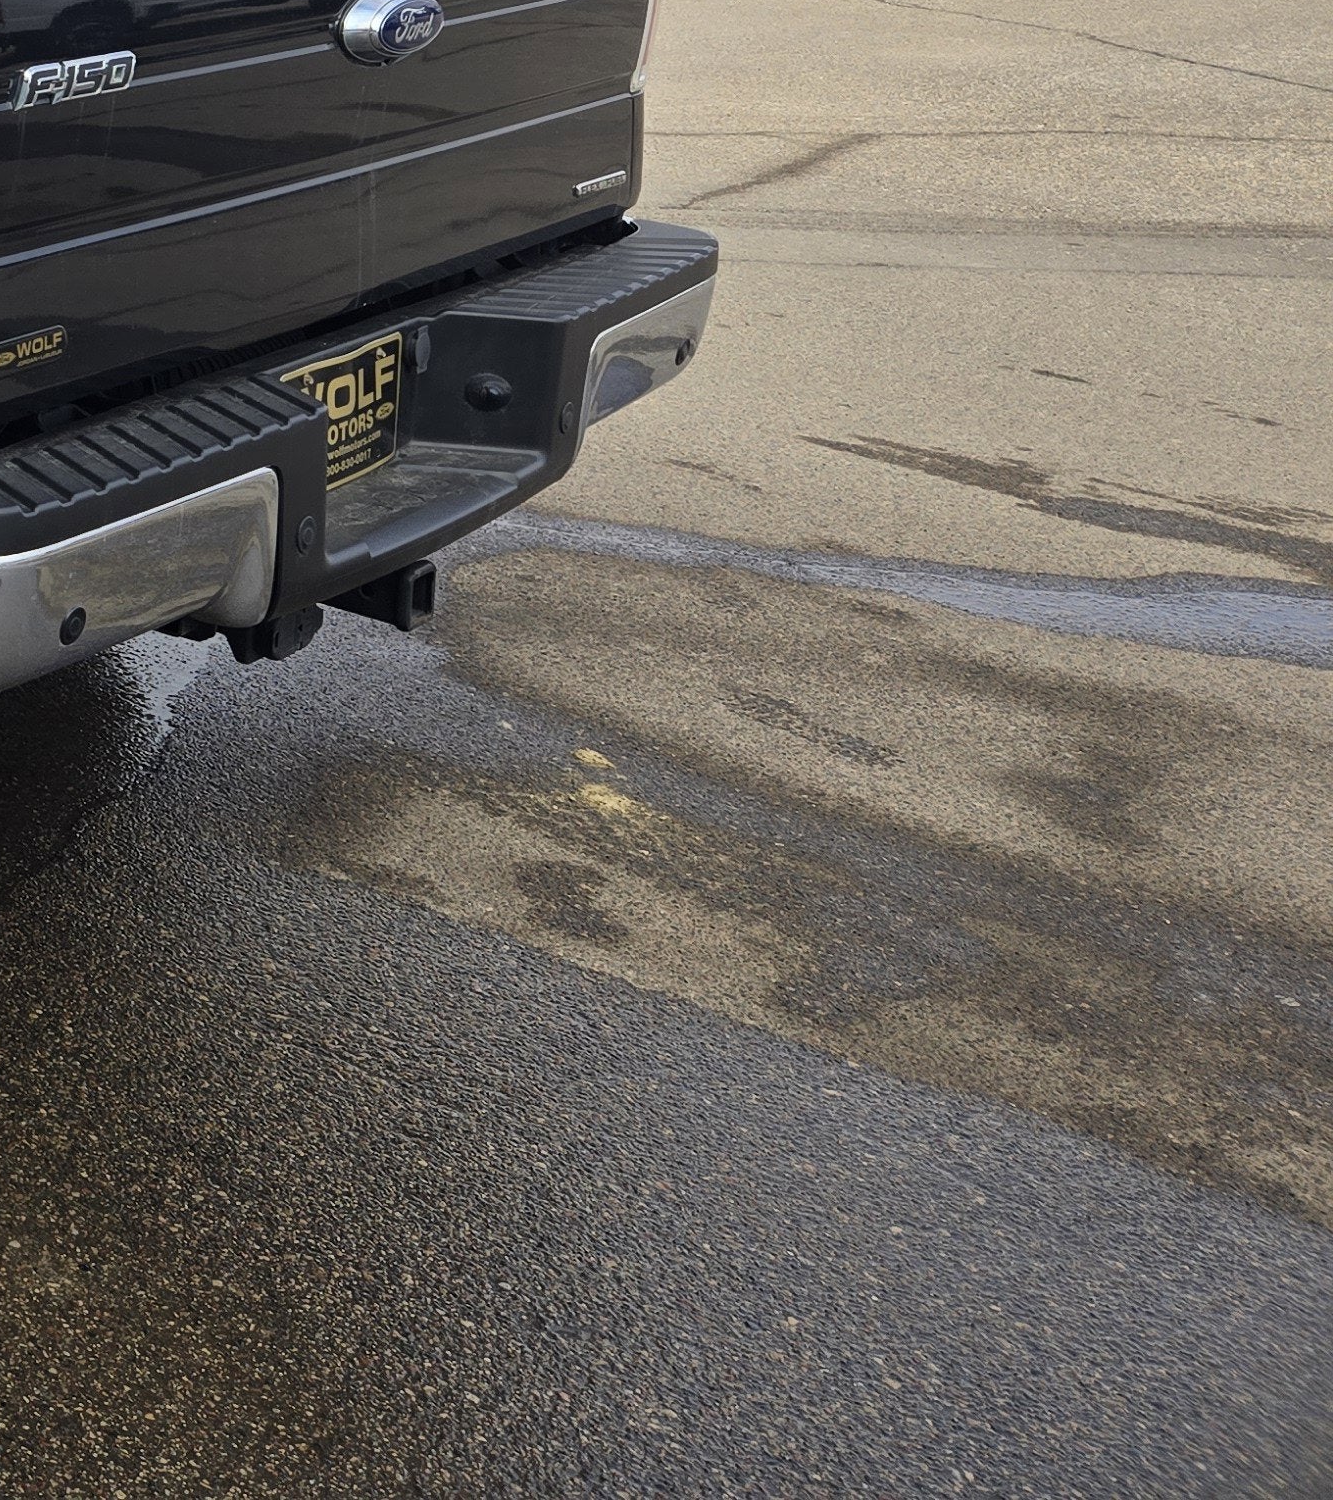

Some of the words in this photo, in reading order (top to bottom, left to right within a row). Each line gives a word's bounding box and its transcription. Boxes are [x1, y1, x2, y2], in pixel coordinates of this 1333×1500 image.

[395, 6, 434, 44] Ford
[16, 331, 63, 358] WOLF
[327, 408, 374, 445] OTORS
